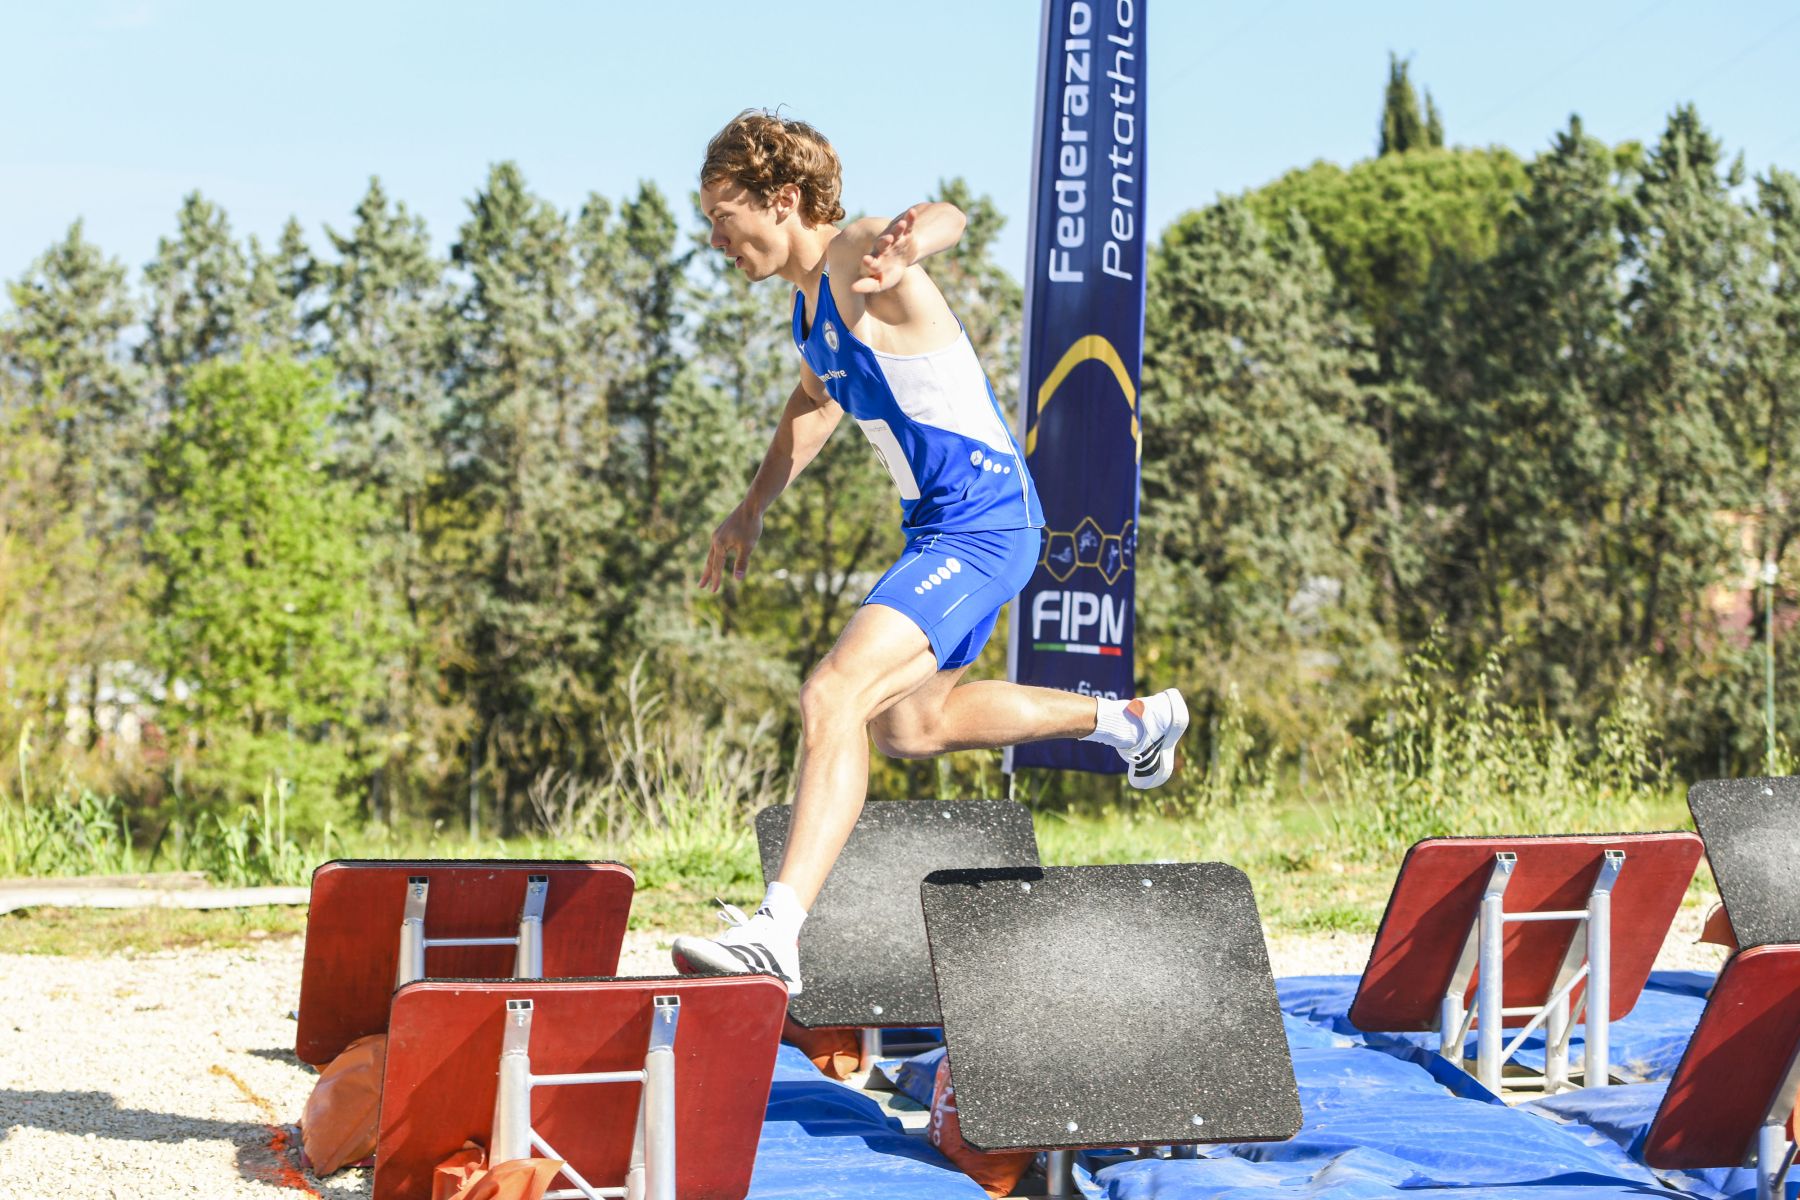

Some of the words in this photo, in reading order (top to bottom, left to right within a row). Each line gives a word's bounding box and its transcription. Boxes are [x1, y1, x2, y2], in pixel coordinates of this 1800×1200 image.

[1049, 1, 1092, 282] Federazio
[1102, 0, 1135, 281] Pentathlo
[1032, 590, 1126, 645] FIPN
